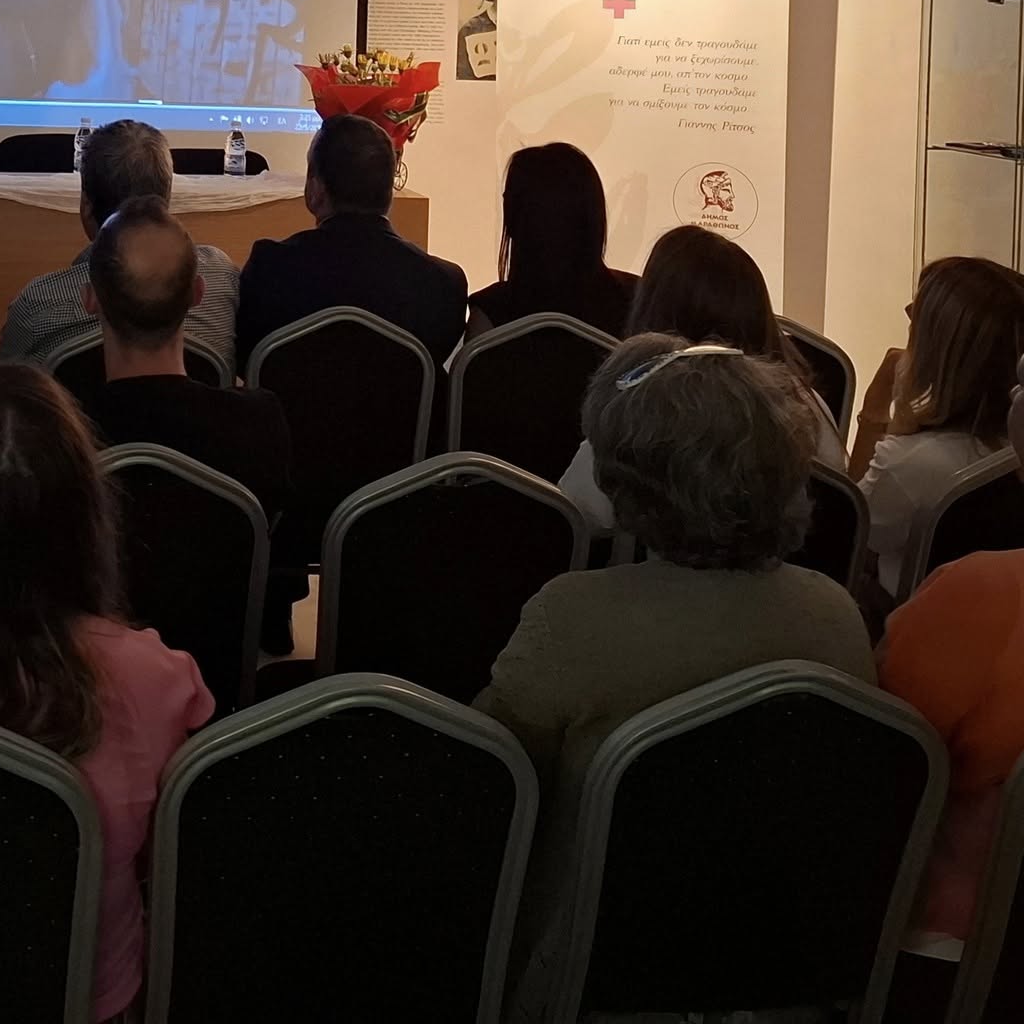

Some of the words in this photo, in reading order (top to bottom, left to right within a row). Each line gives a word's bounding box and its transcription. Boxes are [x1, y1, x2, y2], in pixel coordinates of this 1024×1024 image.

[674, 37, 693, 48] δεν
[655, 54, 671, 64] για
[674, 55, 687, 63] να
[628, 99, 640, 107] να
[694, 103, 710, 111] τον
